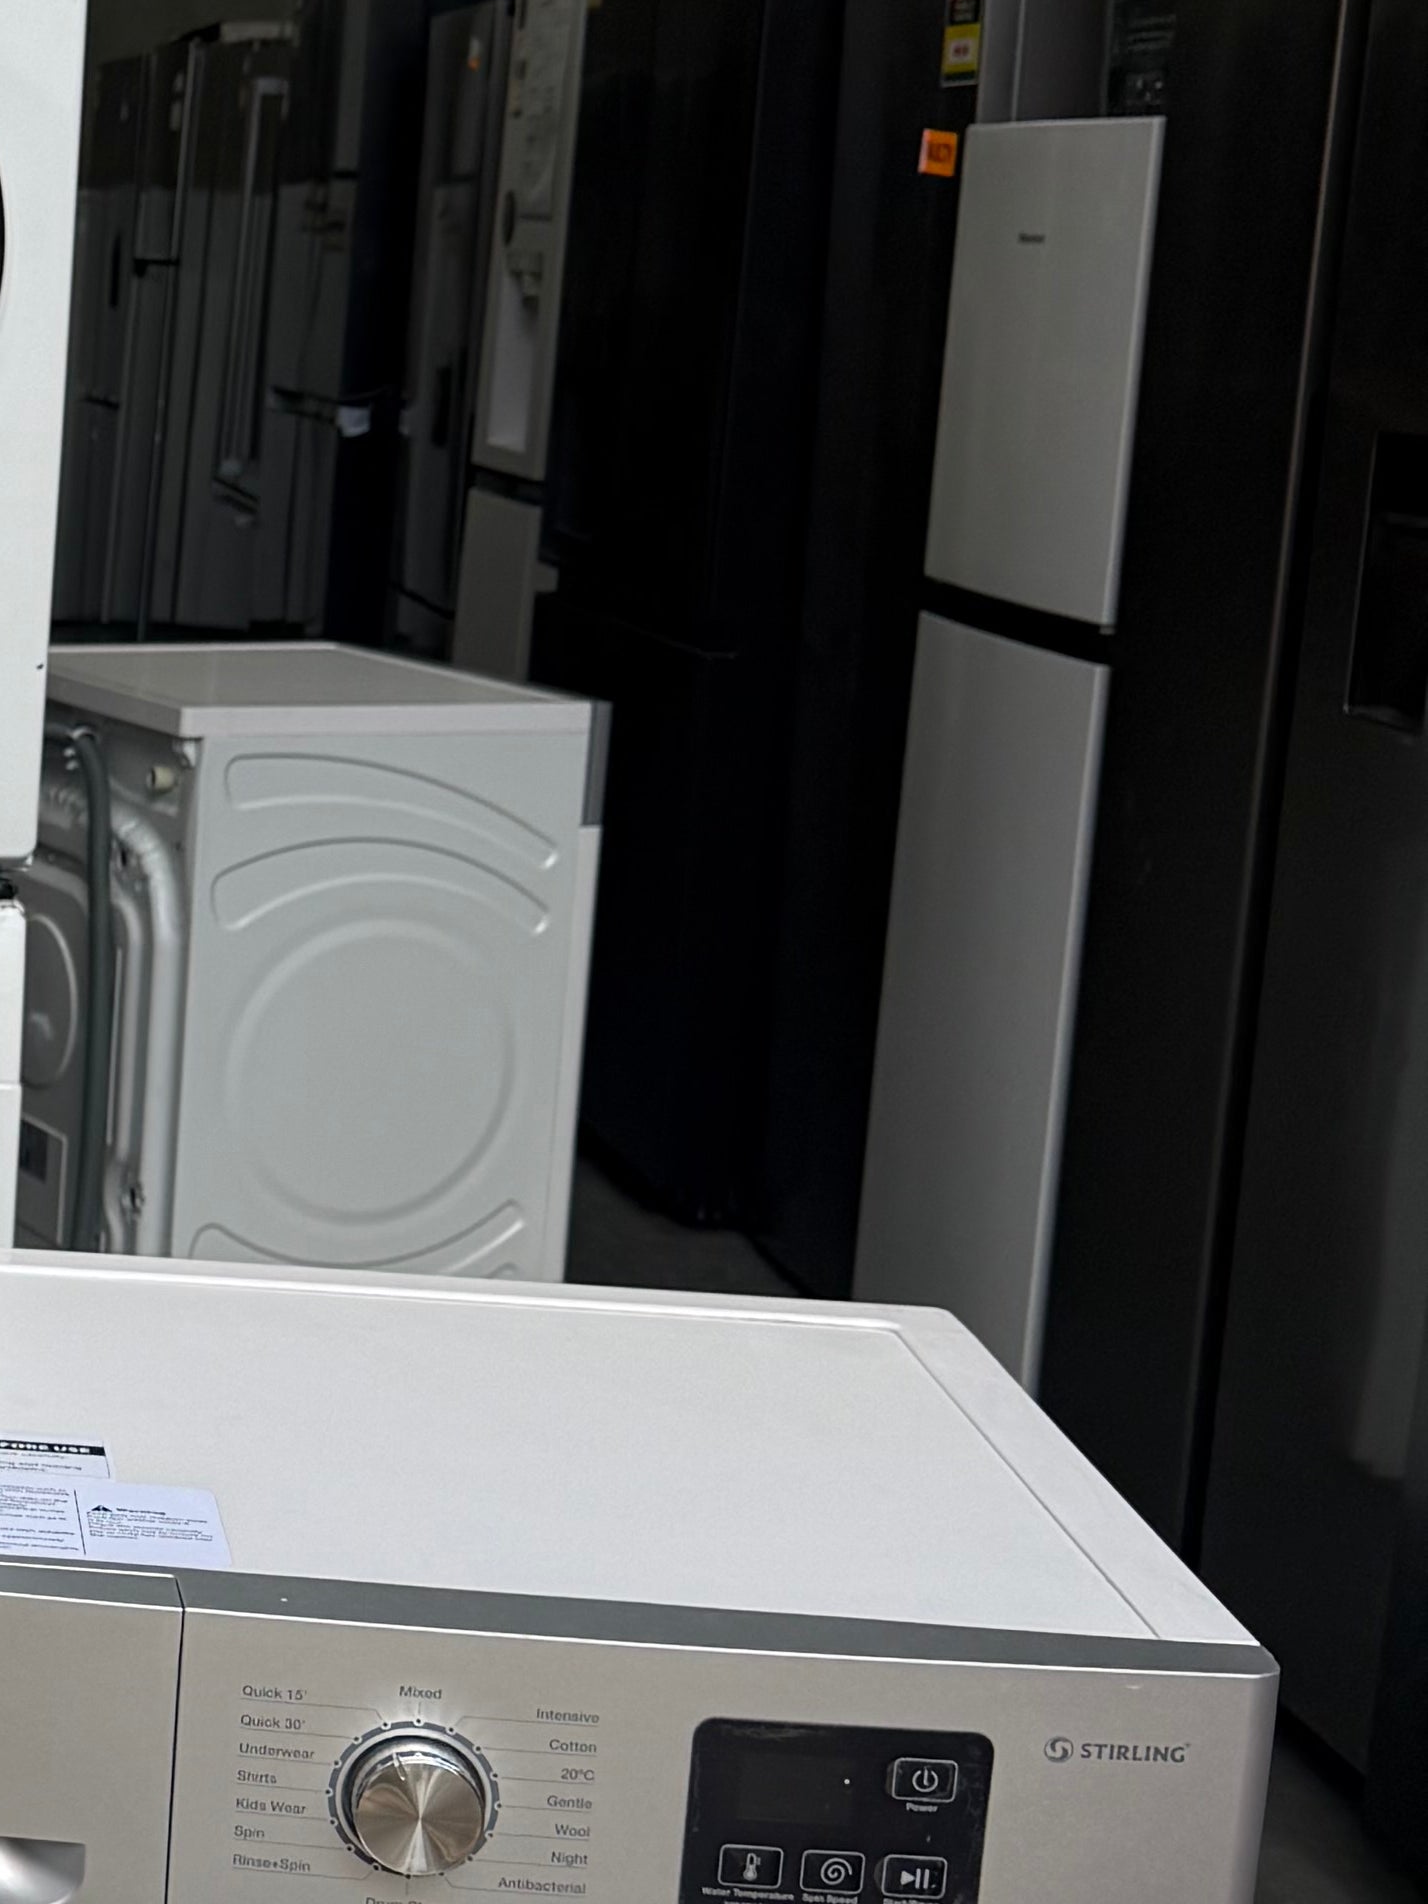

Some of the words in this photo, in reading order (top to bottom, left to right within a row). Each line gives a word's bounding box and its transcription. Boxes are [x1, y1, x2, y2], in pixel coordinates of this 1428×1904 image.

[54, 1445, 90, 1454] USE
[242, 1685, 282, 1699] Quick
[399, 1685, 442, 1700] Mixed
[240, 1714, 280, 1728] Quick
[536, 1708, 600, 1723] Intensive
[239, 1743, 314, 1759] Underwear
[549, 1739, 597, 1752] Cotton
[1080, 1743, 1185, 1763] STIRLING
[237, 1770, 277, 1784] Shirts
[561, 1768, 594, 1781] 20°C
[236, 1798, 266, 1811] Kids
[270, 1801, 306, 1815] Wear
[547, 1795, 592, 1809] Gentle
[906, 1802, 938, 1813] Power
[234, 1825, 264, 1839] Spin
[555, 1824, 590, 1837] Wool
[233, 1854, 310, 1872] Rinse+Spin
[551, 1852, 588, 1866] Night
[498, 1877, 586, 1894] Antibacterial
[733, 1888, 794, 1901] Temperature
[827, 1895, 858, 1904] Speed
